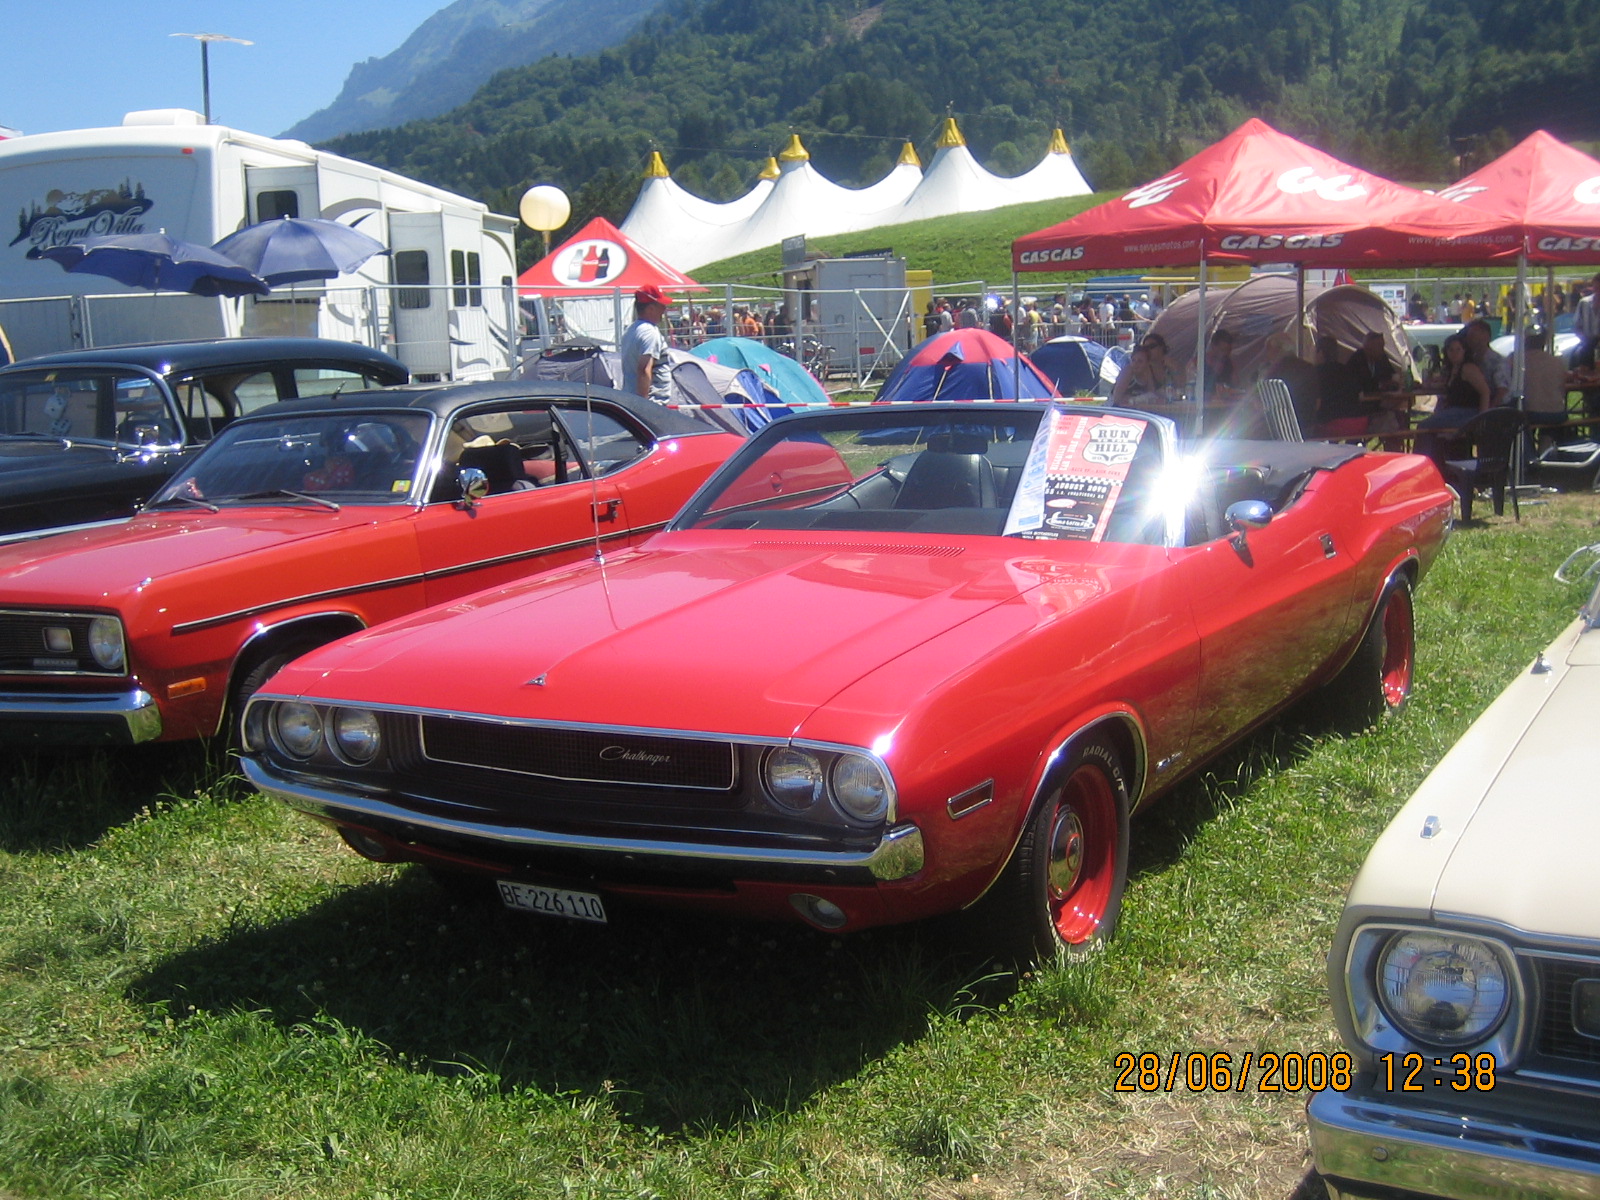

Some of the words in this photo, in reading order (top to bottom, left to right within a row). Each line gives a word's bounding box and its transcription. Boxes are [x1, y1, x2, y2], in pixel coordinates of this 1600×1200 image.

[30, 216, 93, 247] Royal
[92, 206, 145, 236] Villa
[1098, 429, 1131, 439] RUN
[1094, 443, 1129, 453] HILL
[1054, 482, 1085, 491] AUGUST
[599, 745, 672, 766] Challenger
[1082, 745, 1112, 768] RADIAL
